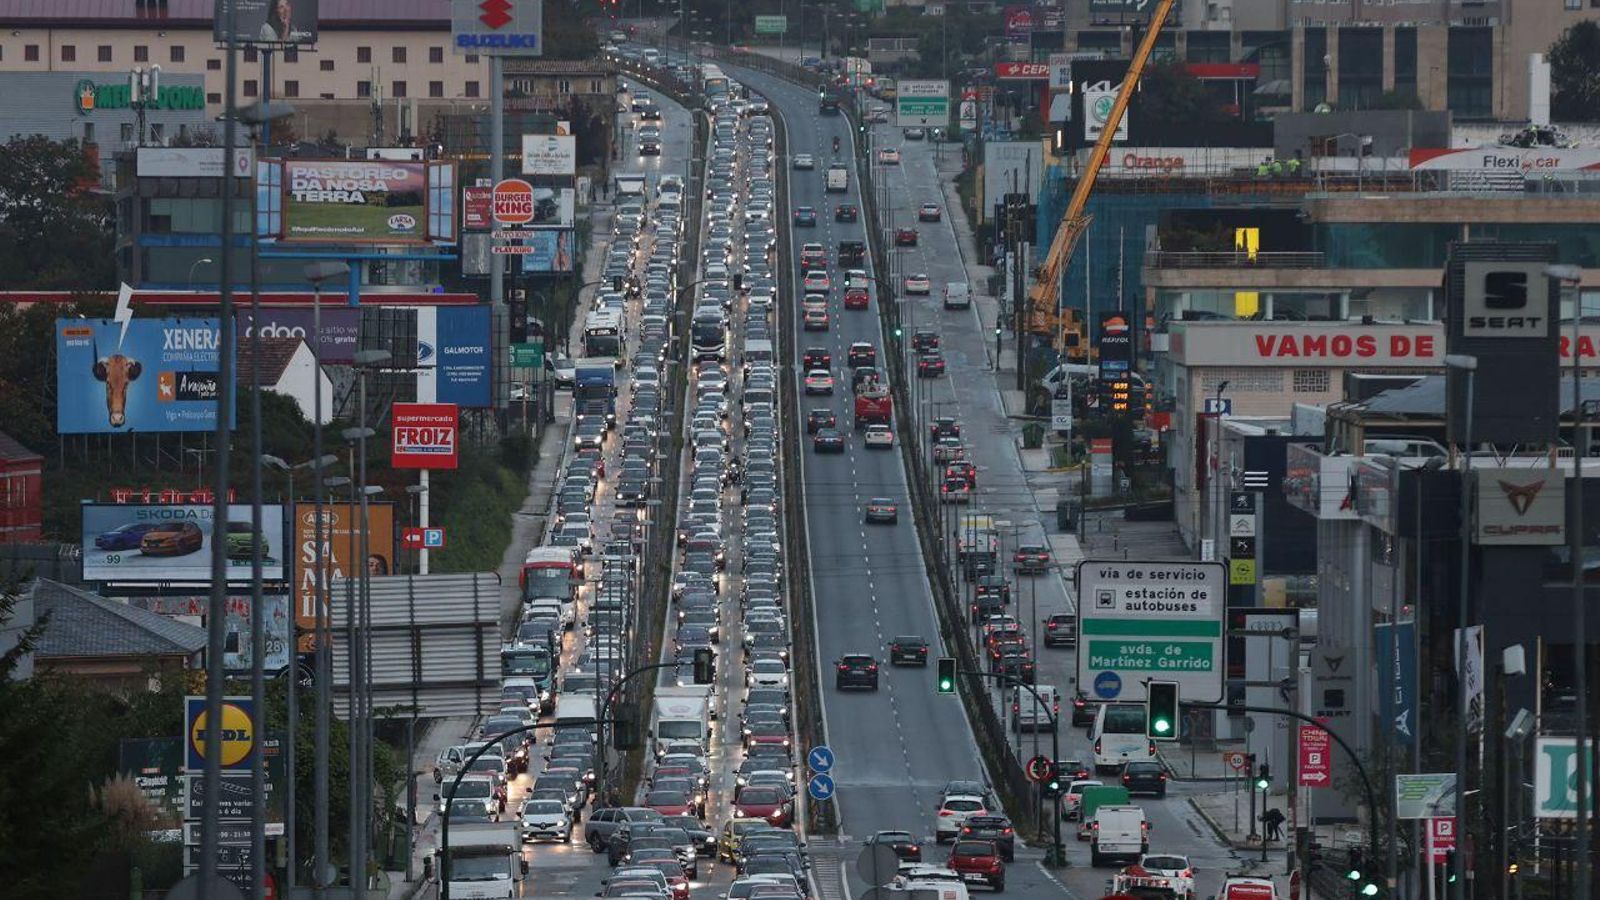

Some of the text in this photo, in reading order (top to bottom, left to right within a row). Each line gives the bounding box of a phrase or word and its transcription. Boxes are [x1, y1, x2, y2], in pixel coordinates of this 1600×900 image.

[457, 34, 536, 48] SUZUKI
[1022, 64, 1049, 75] CEP
[96, 84, 206, 111] MERDONA
[1124, 153, 1185, 172] Orange
[1483, 155, 1561, 168] Flexi car
[292, 167, 409, 180] PASTOREO
[292, 179, 389, 192] DA NOSA
[292, 191, 366, 203] TERRA
[494, 193, 532, 202] BURGER
[494, 202, 533, 214] KING
[1469, 316, 1543, 328] SEAT
[163, 328, 221, 350] XENERA
[444, 346, 484, 355] GALMOTOR
[1255, 334, 1376, 358] VAMOS
[1390, 335, 1434, 358] DE
[193, 350, 220, 362] ELÉCTRIC
[397, 415, 454, 423] supermercado
[396, 427, 452, 446] FROIZ
[1482, 524, 1561, 535] CUPRA
[1126, 568, 1144, 580] de
[1150, 570, 1206, 581] servicio
[1125, 587, 1208, 600] estación de
[1125, 601, 1197, 612] autobuses
[1120, 644, 1182, 656] avda. de
[1091, 655, 1210, 669] Martínez Garrido
